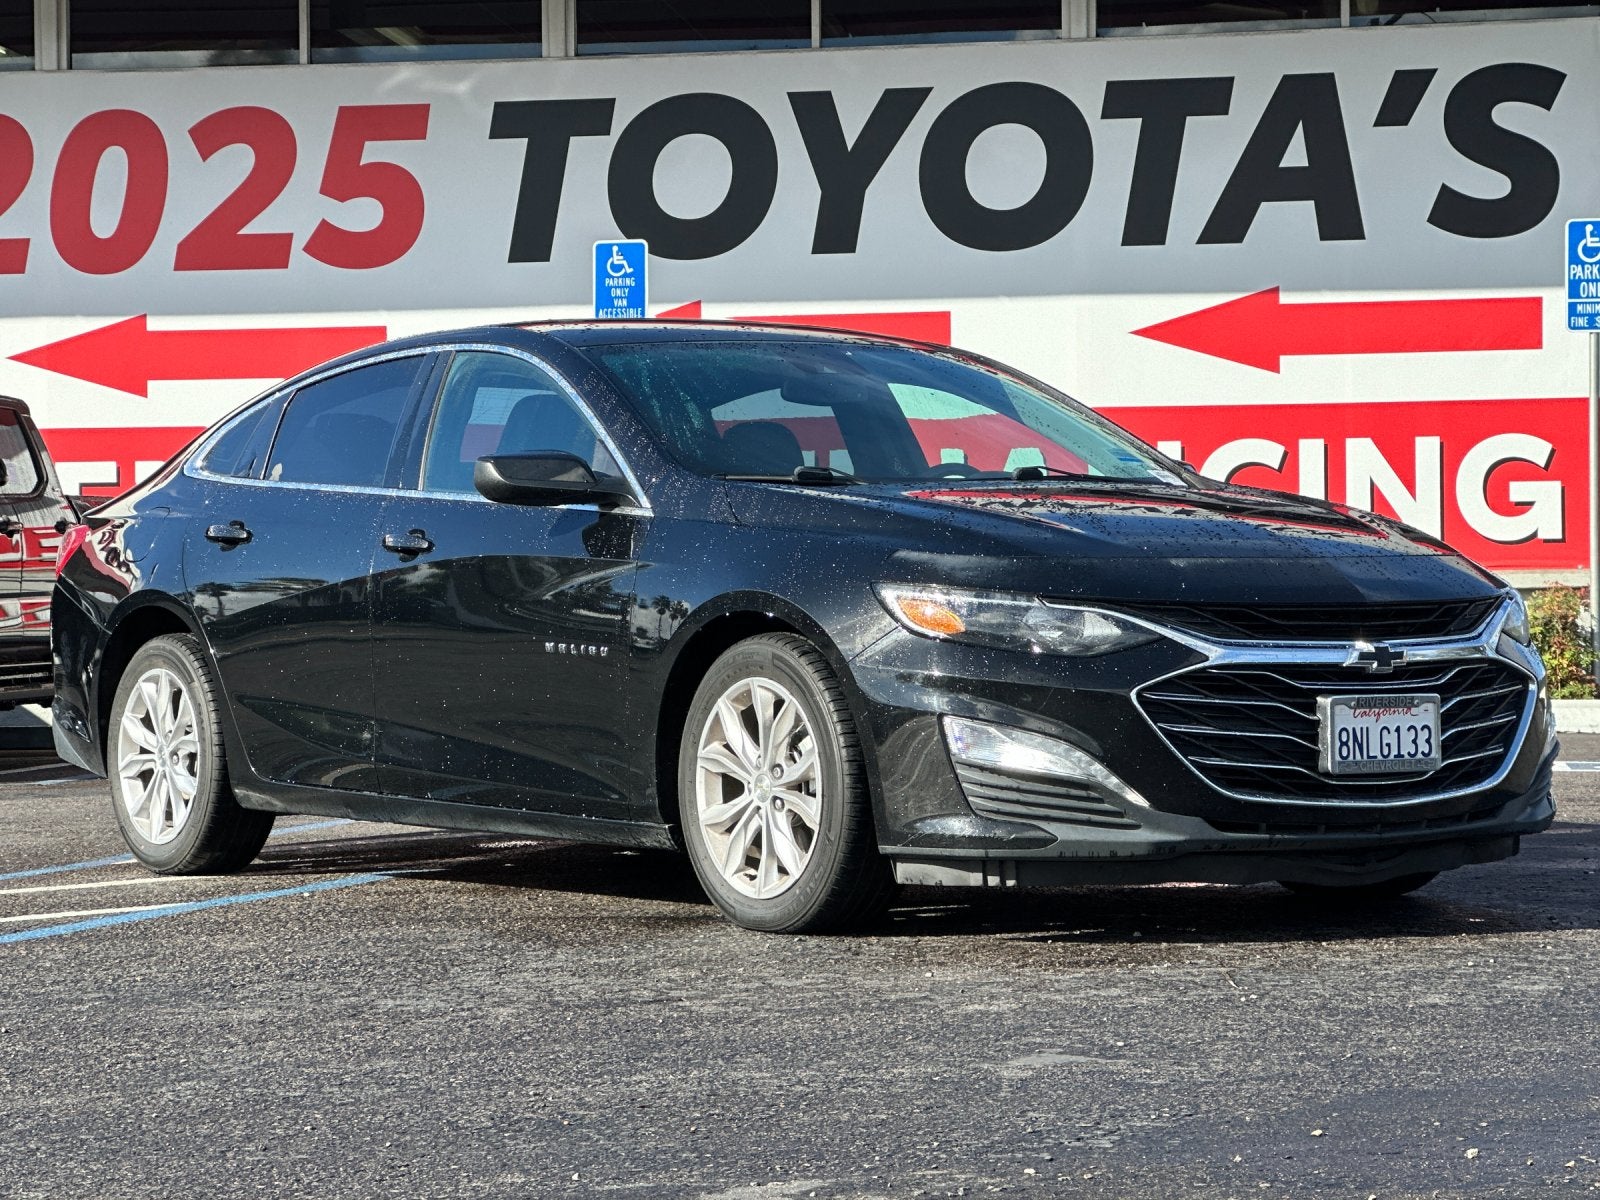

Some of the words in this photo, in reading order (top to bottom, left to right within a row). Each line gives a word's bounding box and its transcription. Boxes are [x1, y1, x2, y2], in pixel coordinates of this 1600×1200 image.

[0, 103, 431, 275] 025
[489, 61, 1568, 262] TOYOTA'S
[1569, 264, 1600, 280] PARK
[605, 277, 636, 287] PARKING
[611, 288, 629, 297] ONLY
[613, 298, 628, 307] VAN
[598, 308, 643, 318] ACCESSIBLE
[1570, 316, 1589, 328] FINE
[544, 641, 609, 657] MALIBU
[1359, 696, 1413, 707] RIVERSIDE
[1338, 724, 1433, 760] 8NLG133
[1360, 759, 1416, 771] CHEVROLET
